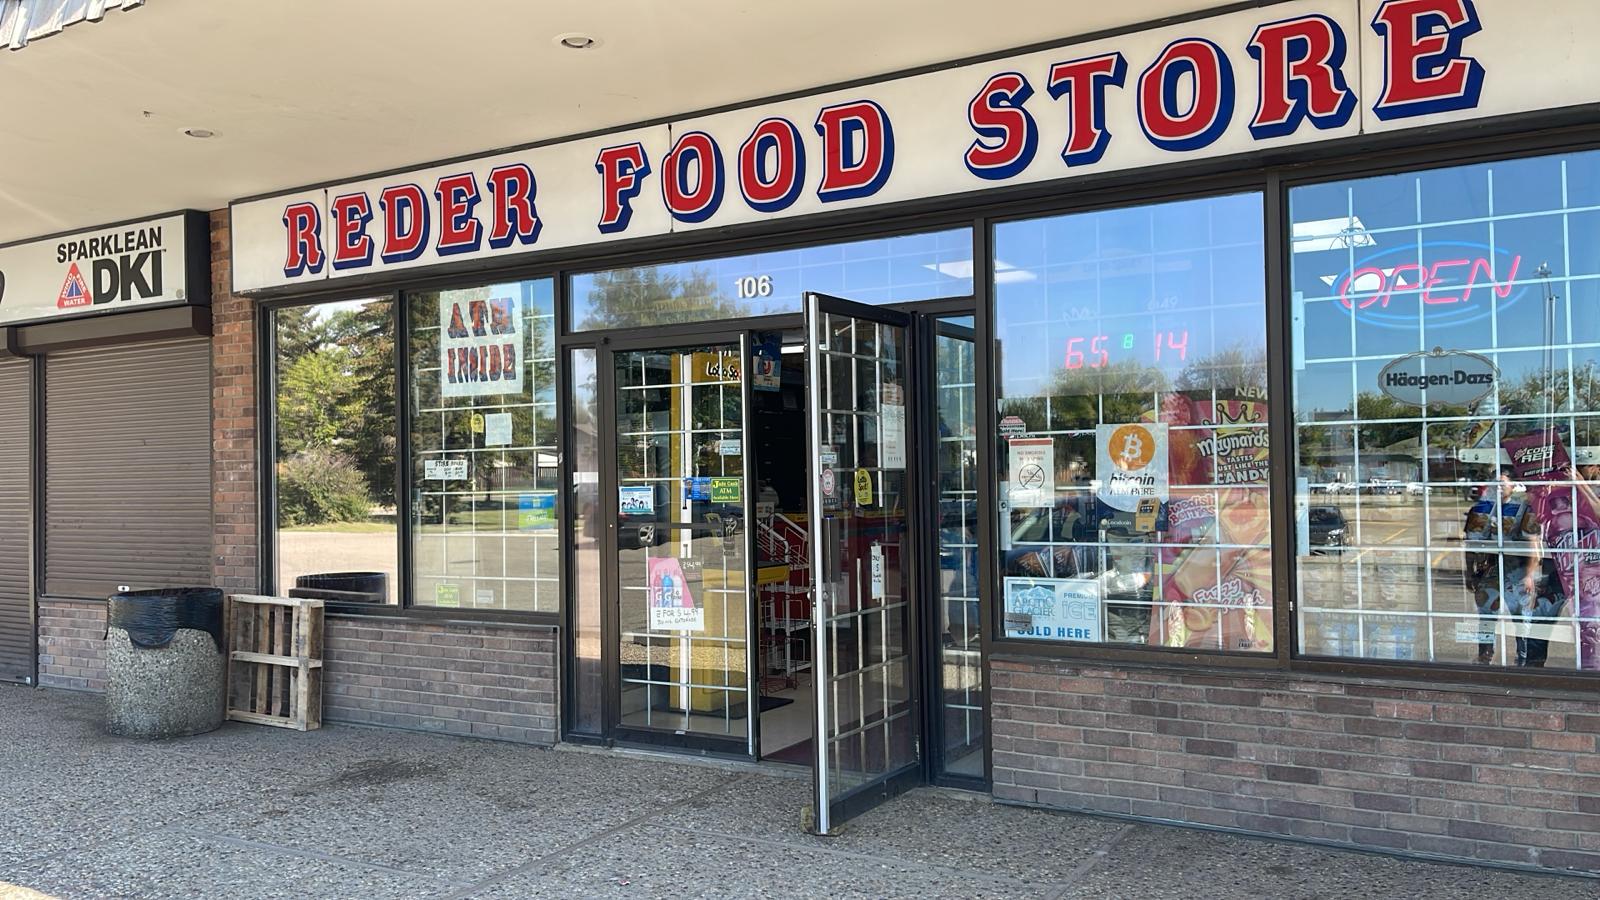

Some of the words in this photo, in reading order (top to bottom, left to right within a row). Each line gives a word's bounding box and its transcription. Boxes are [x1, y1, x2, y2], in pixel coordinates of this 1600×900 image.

[282, 163, 543, 278] REDER
[595, 99, 895, 234] FOOD
[964, 0, 1485, 180] STORE
[57, 226, 161, 263] SPARKLEAN
[93, 250, 163, 305] DKI
[735, 275, 773, 298] 106
[1340, 255, 1521, 309] OPEN
[63, 298, 86, 307] WATER
[447, 297, 516, 339] ATM
[1065, 335, 1109, 369] 65
[1123, 334, 1134, 349] 8
[1155, 331, 1189, 361] 14
[447, 343, 516, 383] INSIDE
[1386, 370, 1493, 389] Häagen-Dazs
[1521, 451, 1553, 463] RED
[1057, 627, 1092, 639] HERE
